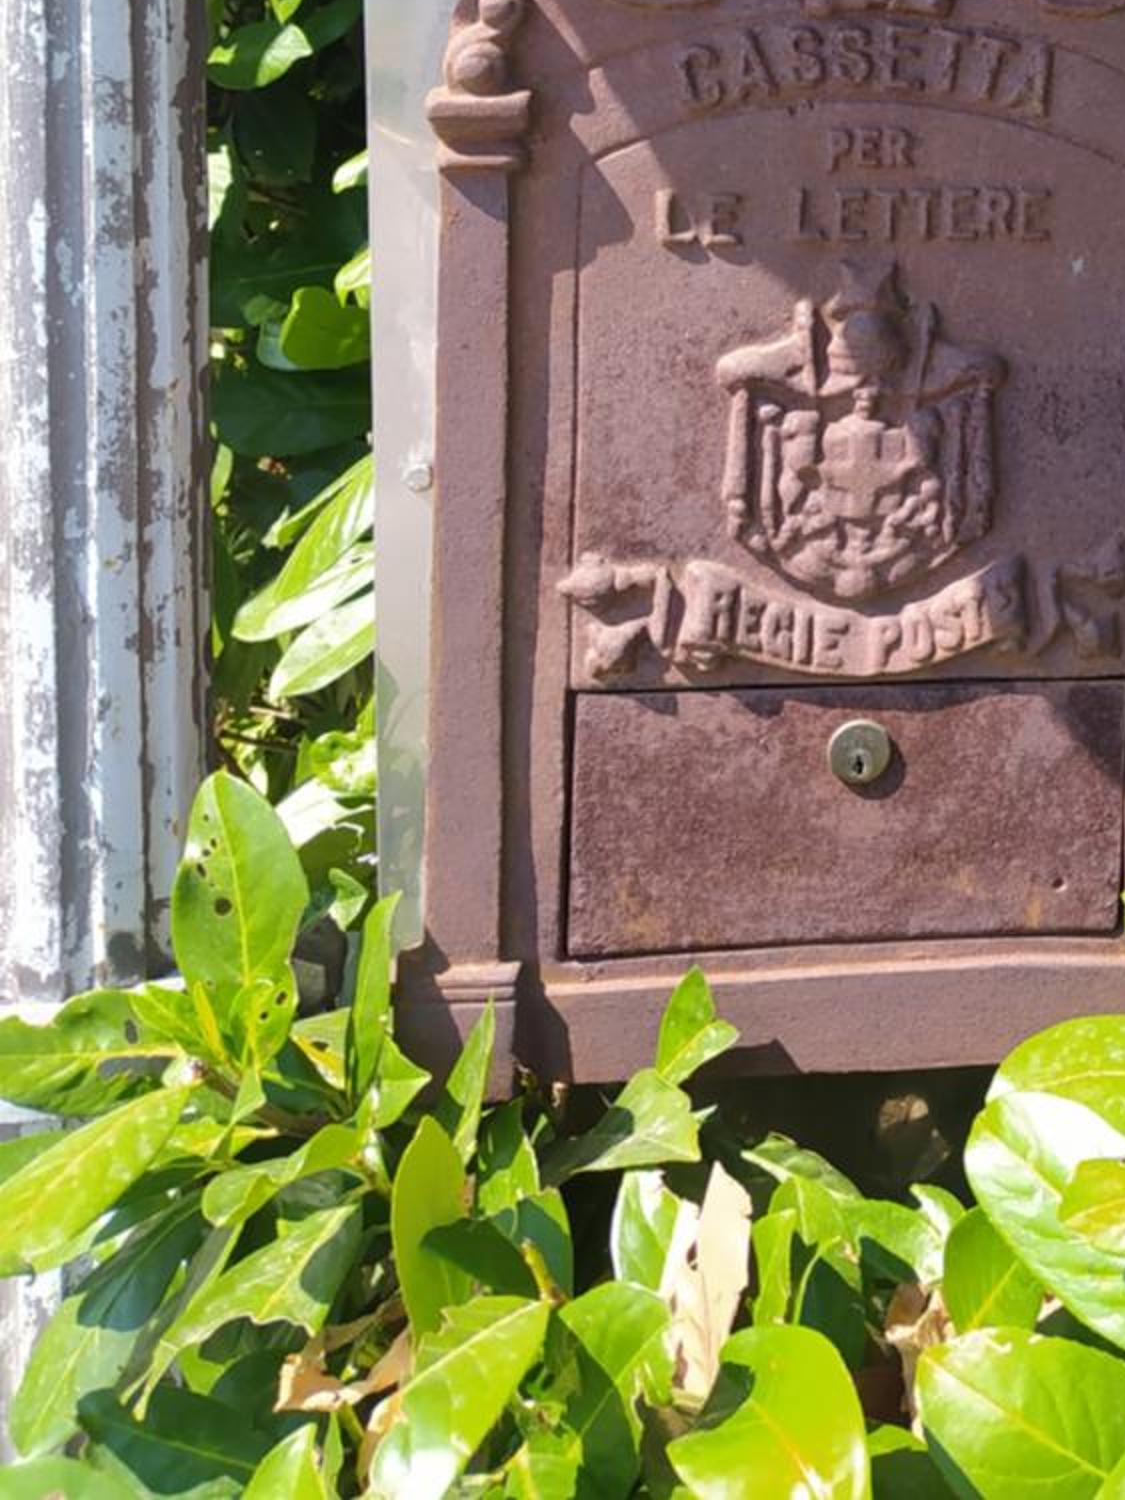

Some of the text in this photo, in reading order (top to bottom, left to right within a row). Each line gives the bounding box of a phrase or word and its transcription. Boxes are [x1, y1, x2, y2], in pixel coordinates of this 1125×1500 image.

[680, 21, 1056, 120] CASSETTA
[826, 127, 916, 173] PER
[655, 186, 1052, 245] LE LETTERE
